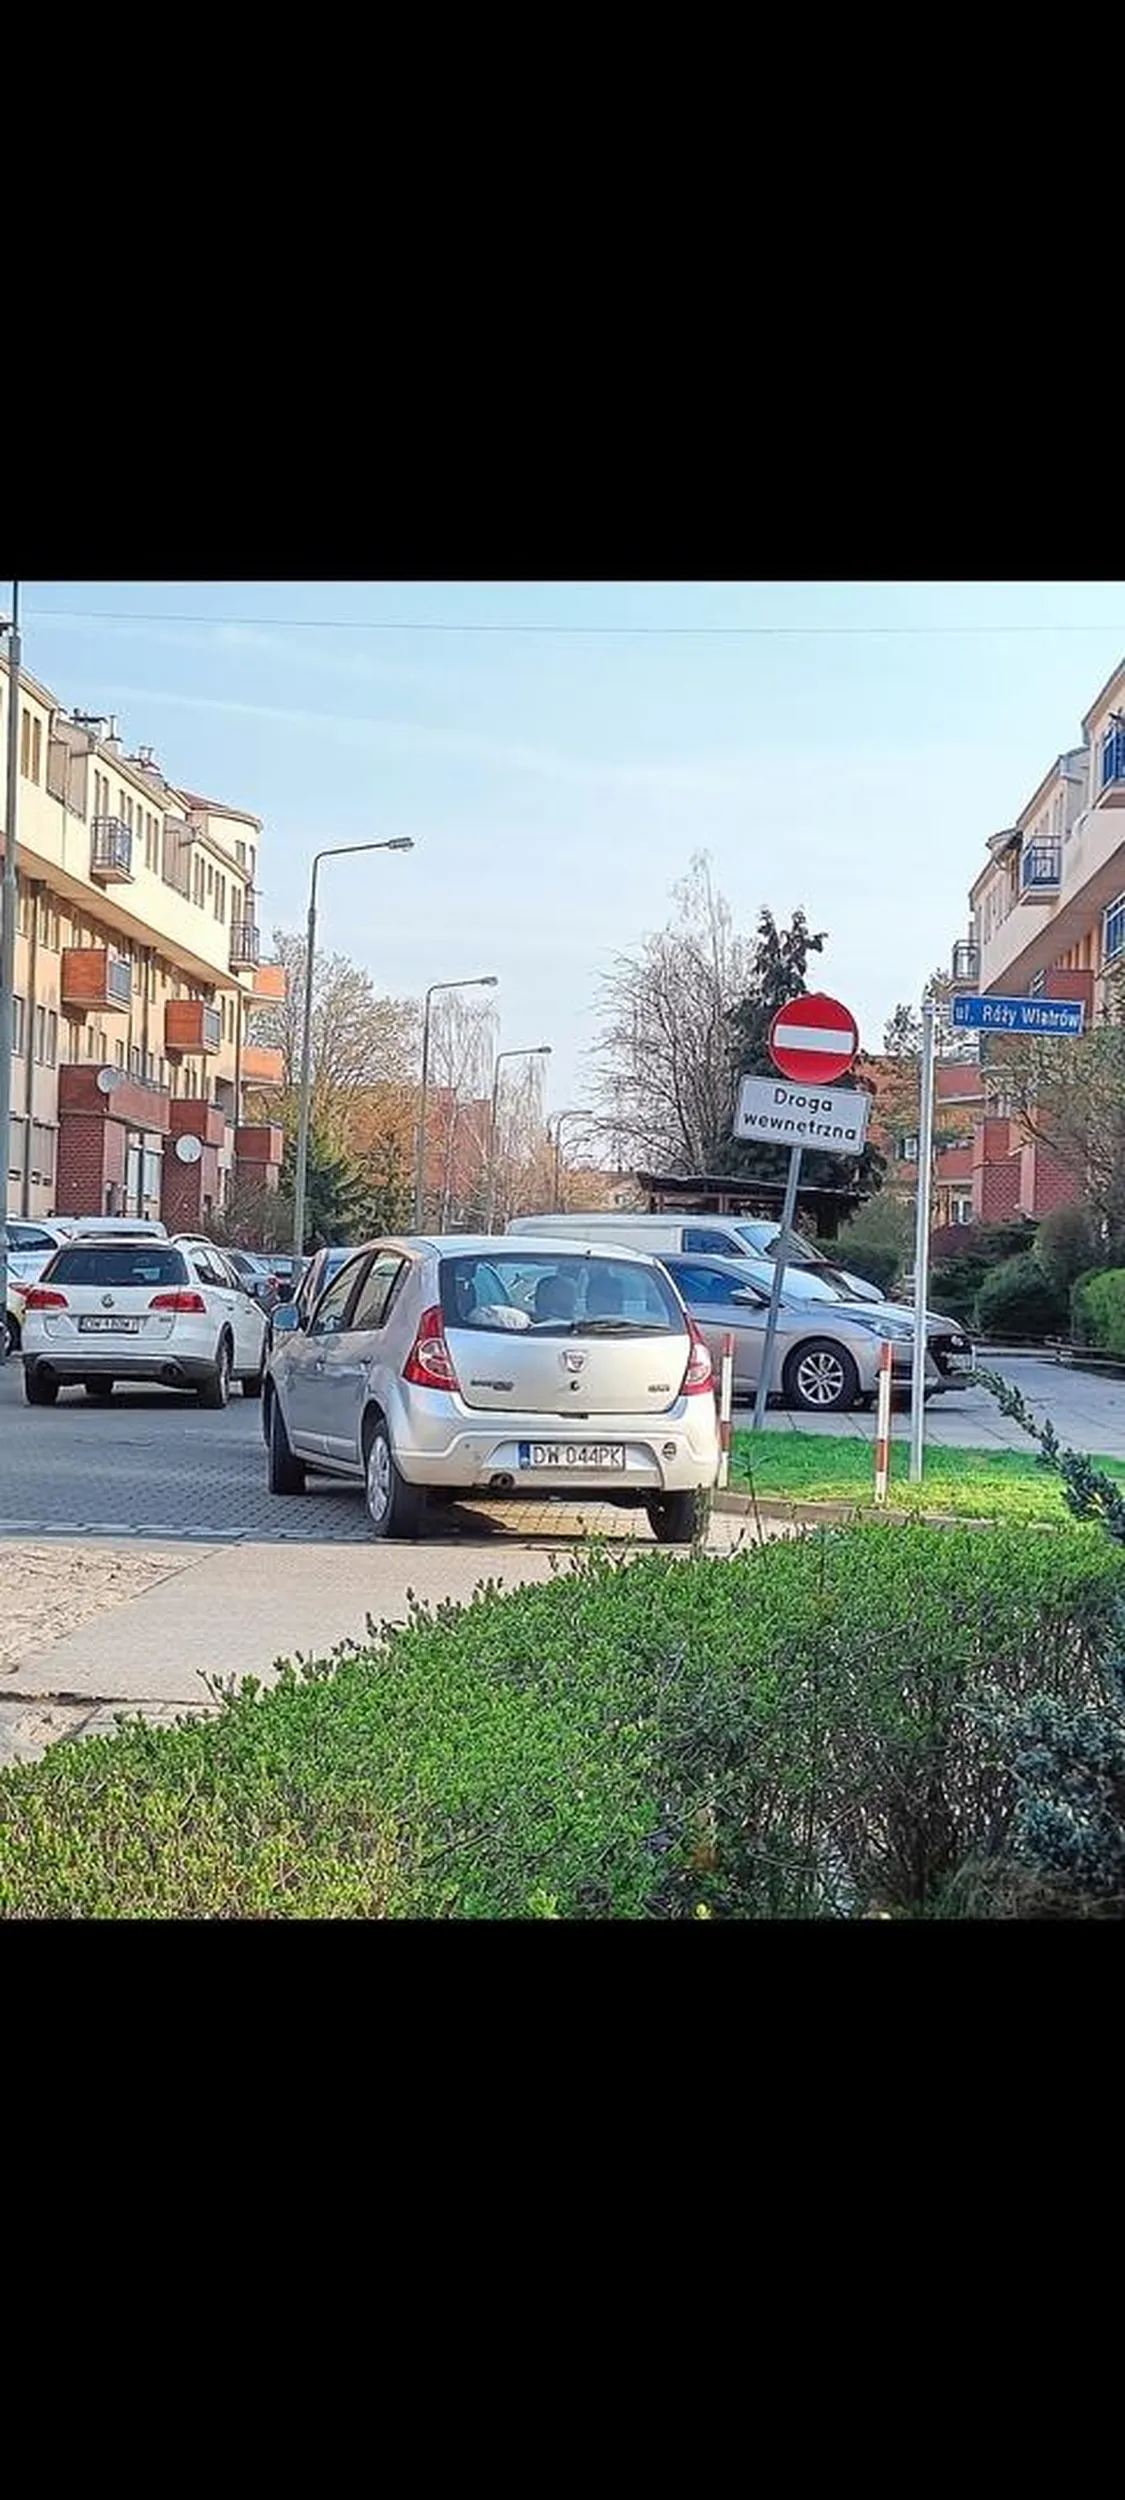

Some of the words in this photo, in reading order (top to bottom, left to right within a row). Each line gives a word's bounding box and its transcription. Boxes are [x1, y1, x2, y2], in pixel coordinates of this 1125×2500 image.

[955, 1004, 974, 1022] ul.
[983, 1004, 1017, 1026] Róży
[775, 1087, 832, 1114] Droga
[743, 1113, 856, 1140] wewnętrzna
[533, 1444, 560, 1464] DW
[566, 1444, 619, 1465] 044PK
